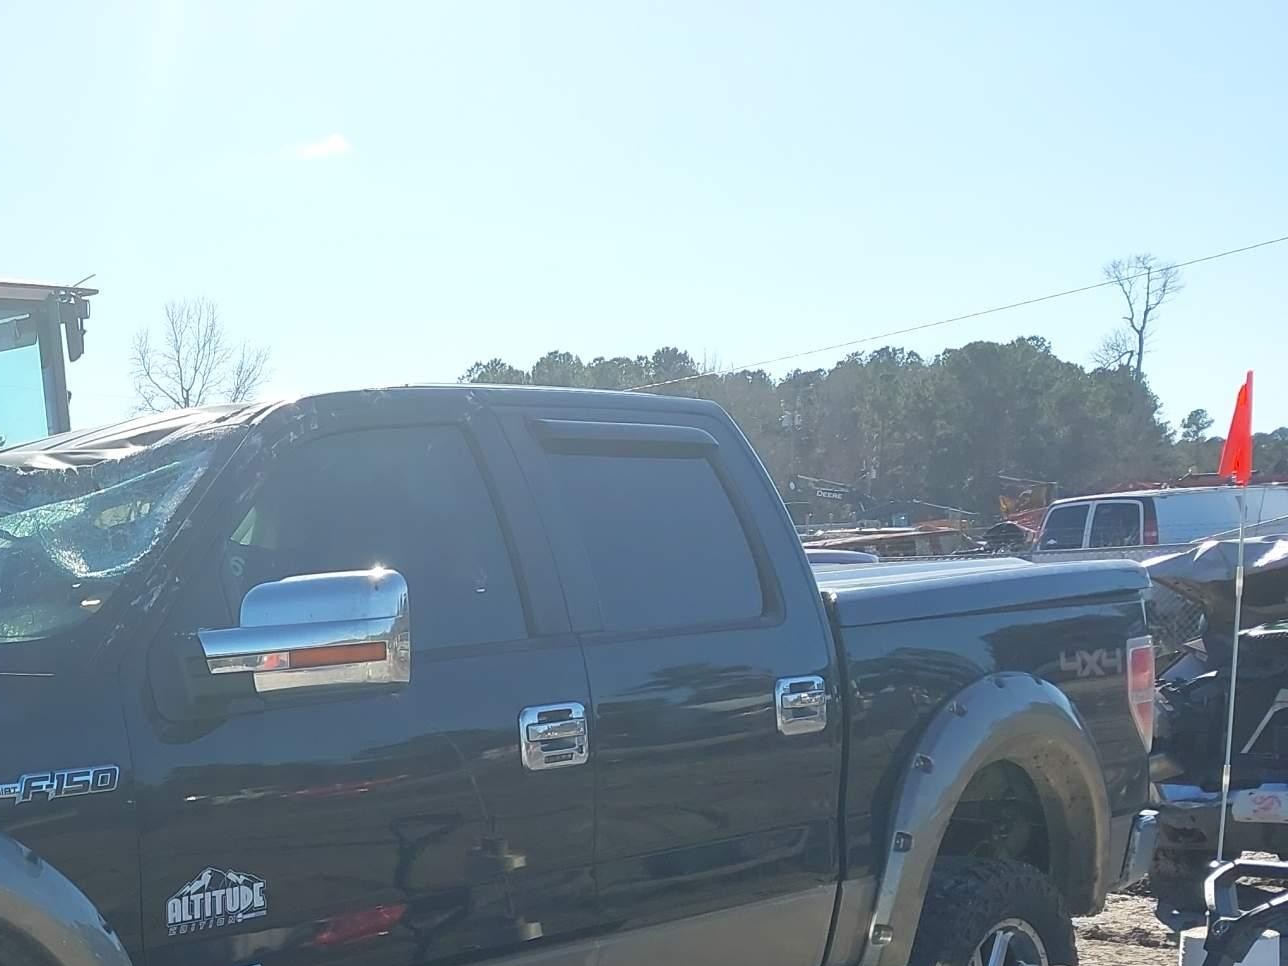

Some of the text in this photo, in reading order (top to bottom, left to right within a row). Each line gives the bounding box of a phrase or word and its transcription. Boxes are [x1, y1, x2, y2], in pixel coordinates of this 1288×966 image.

[815, 489, 843, 500] DEERE
[20, 765, 121, 803] F-150
[168, 881, 265, 924] ALTITUDE
